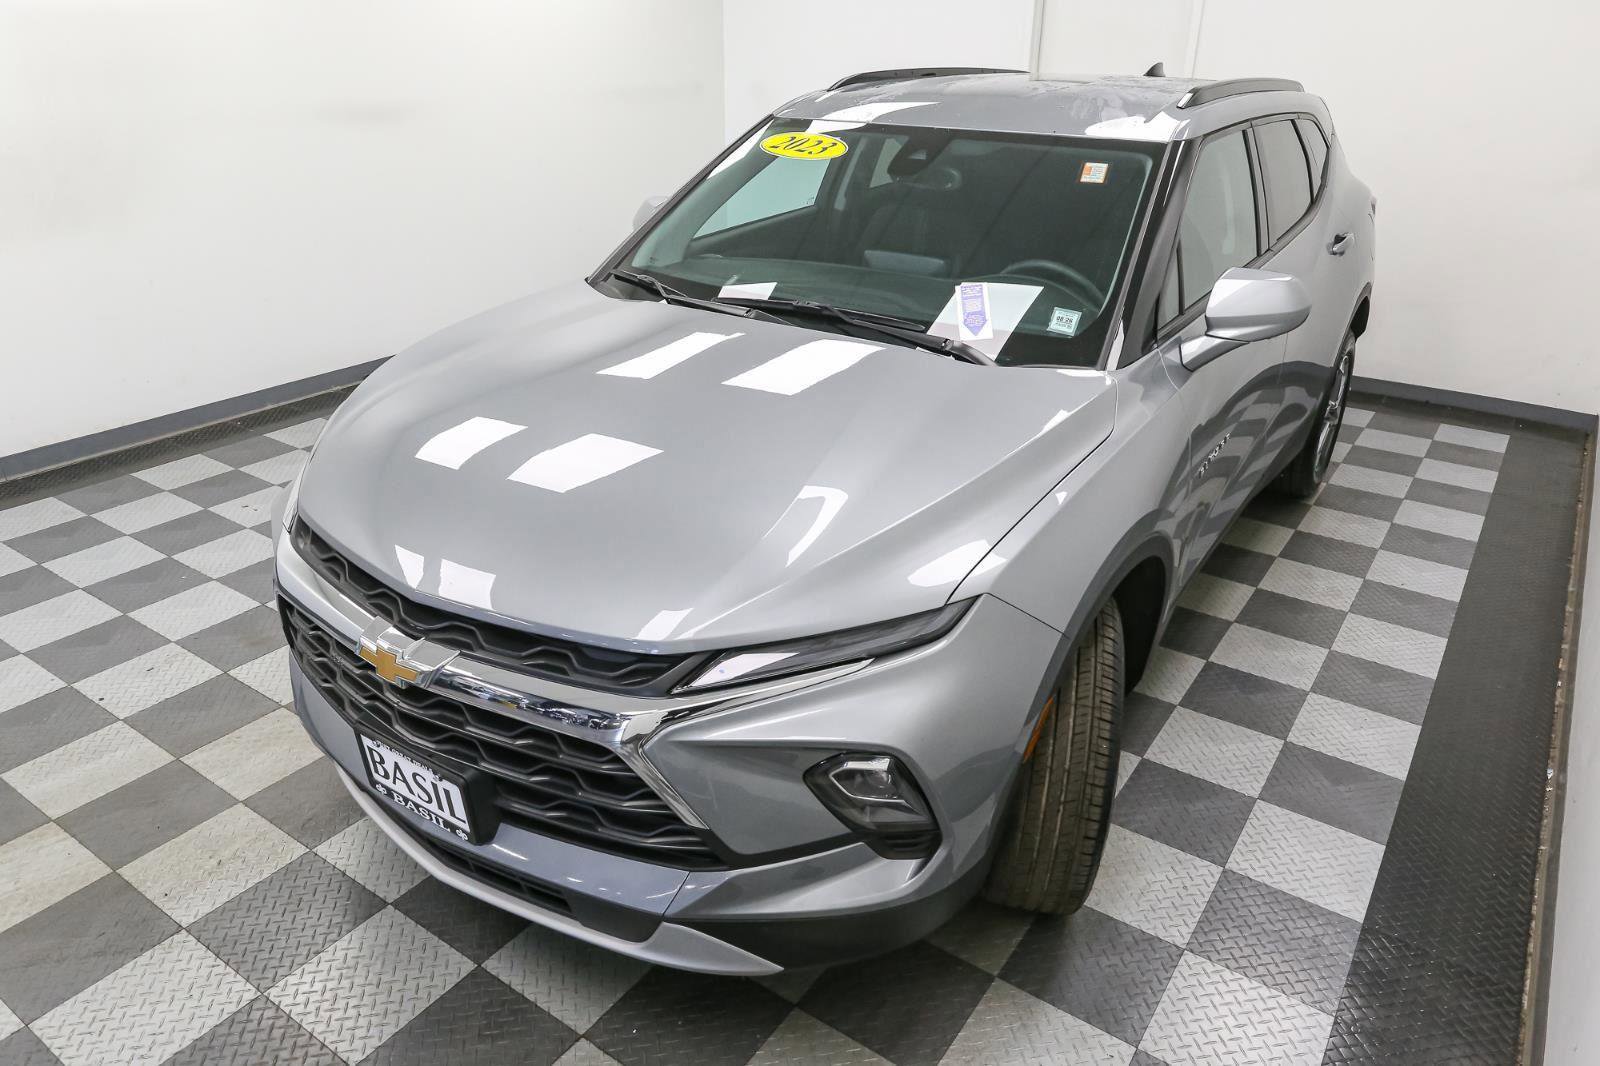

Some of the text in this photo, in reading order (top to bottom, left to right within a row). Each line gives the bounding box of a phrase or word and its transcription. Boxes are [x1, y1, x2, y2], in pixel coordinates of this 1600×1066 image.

[769, 136, 837, 154] 2023
[366, 745, 467, 824] BASIL
[392, 792, 451, 832] BASIL
